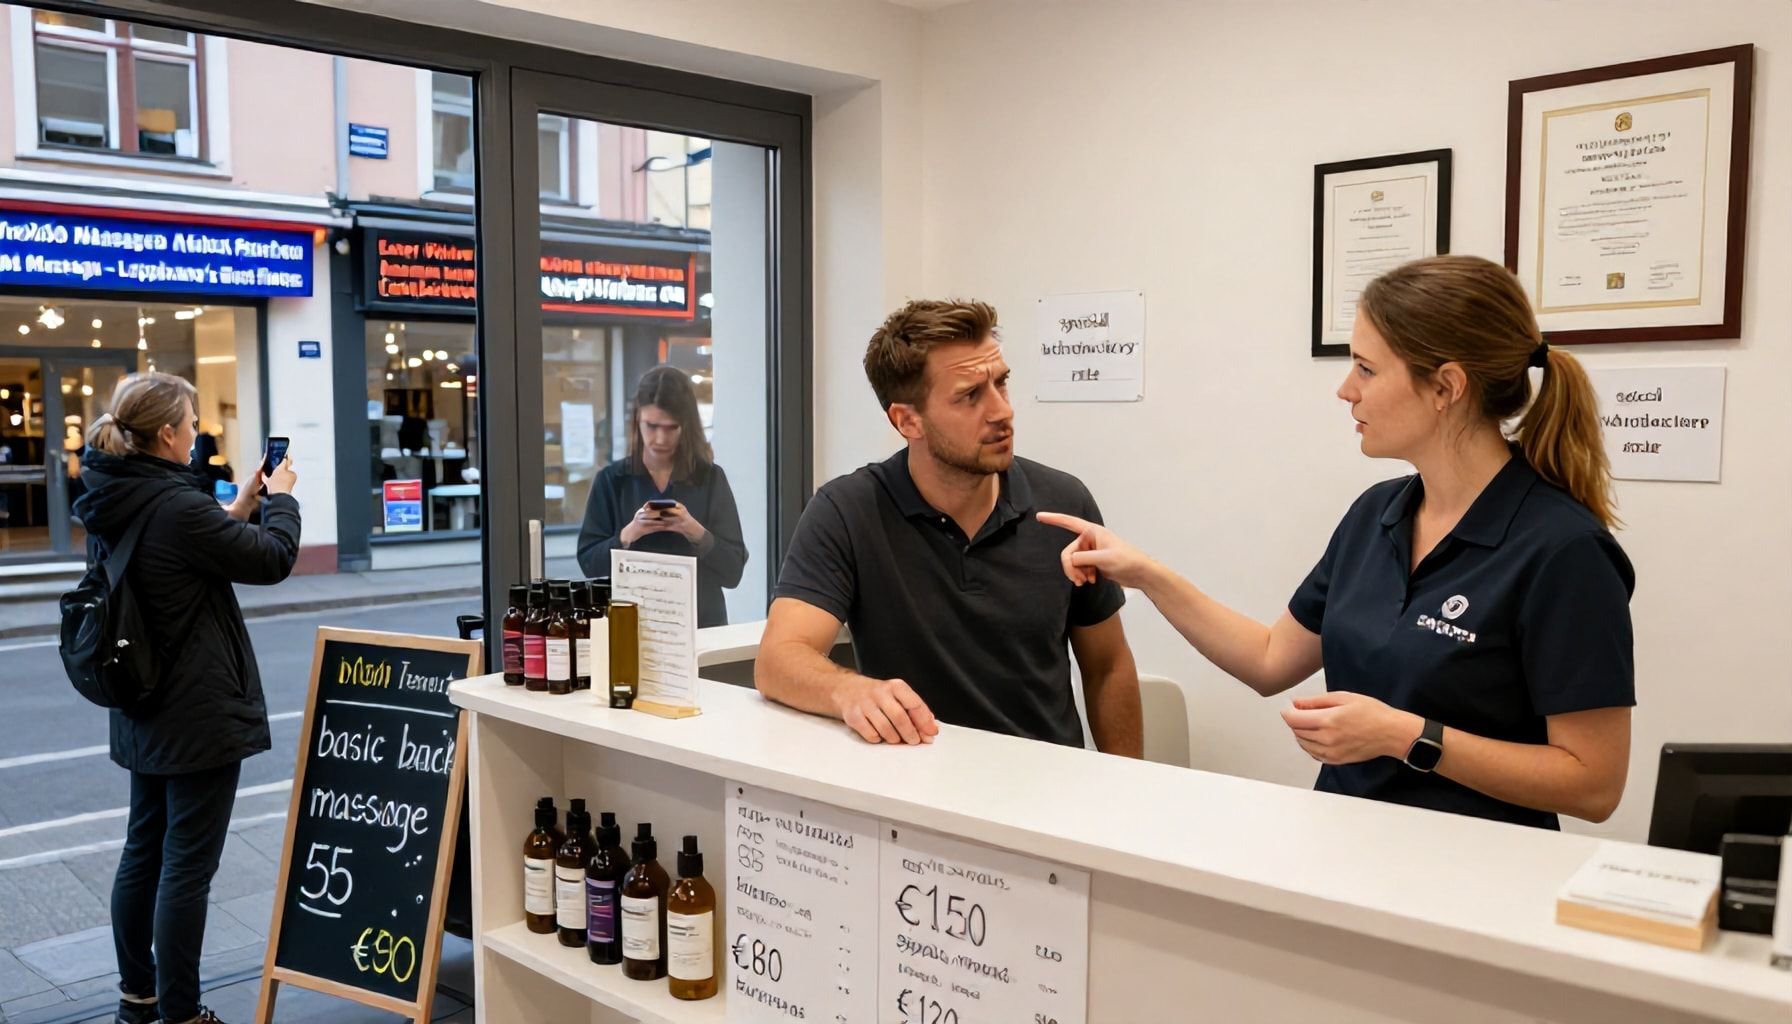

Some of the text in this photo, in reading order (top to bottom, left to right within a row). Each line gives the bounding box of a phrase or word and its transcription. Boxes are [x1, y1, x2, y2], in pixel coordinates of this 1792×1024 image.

[318, 715, 386, 763] basic
[310, 788, 428, 853] massage
[300, 842, 353, 906] 55
[895, 885, 986, 946] €150
